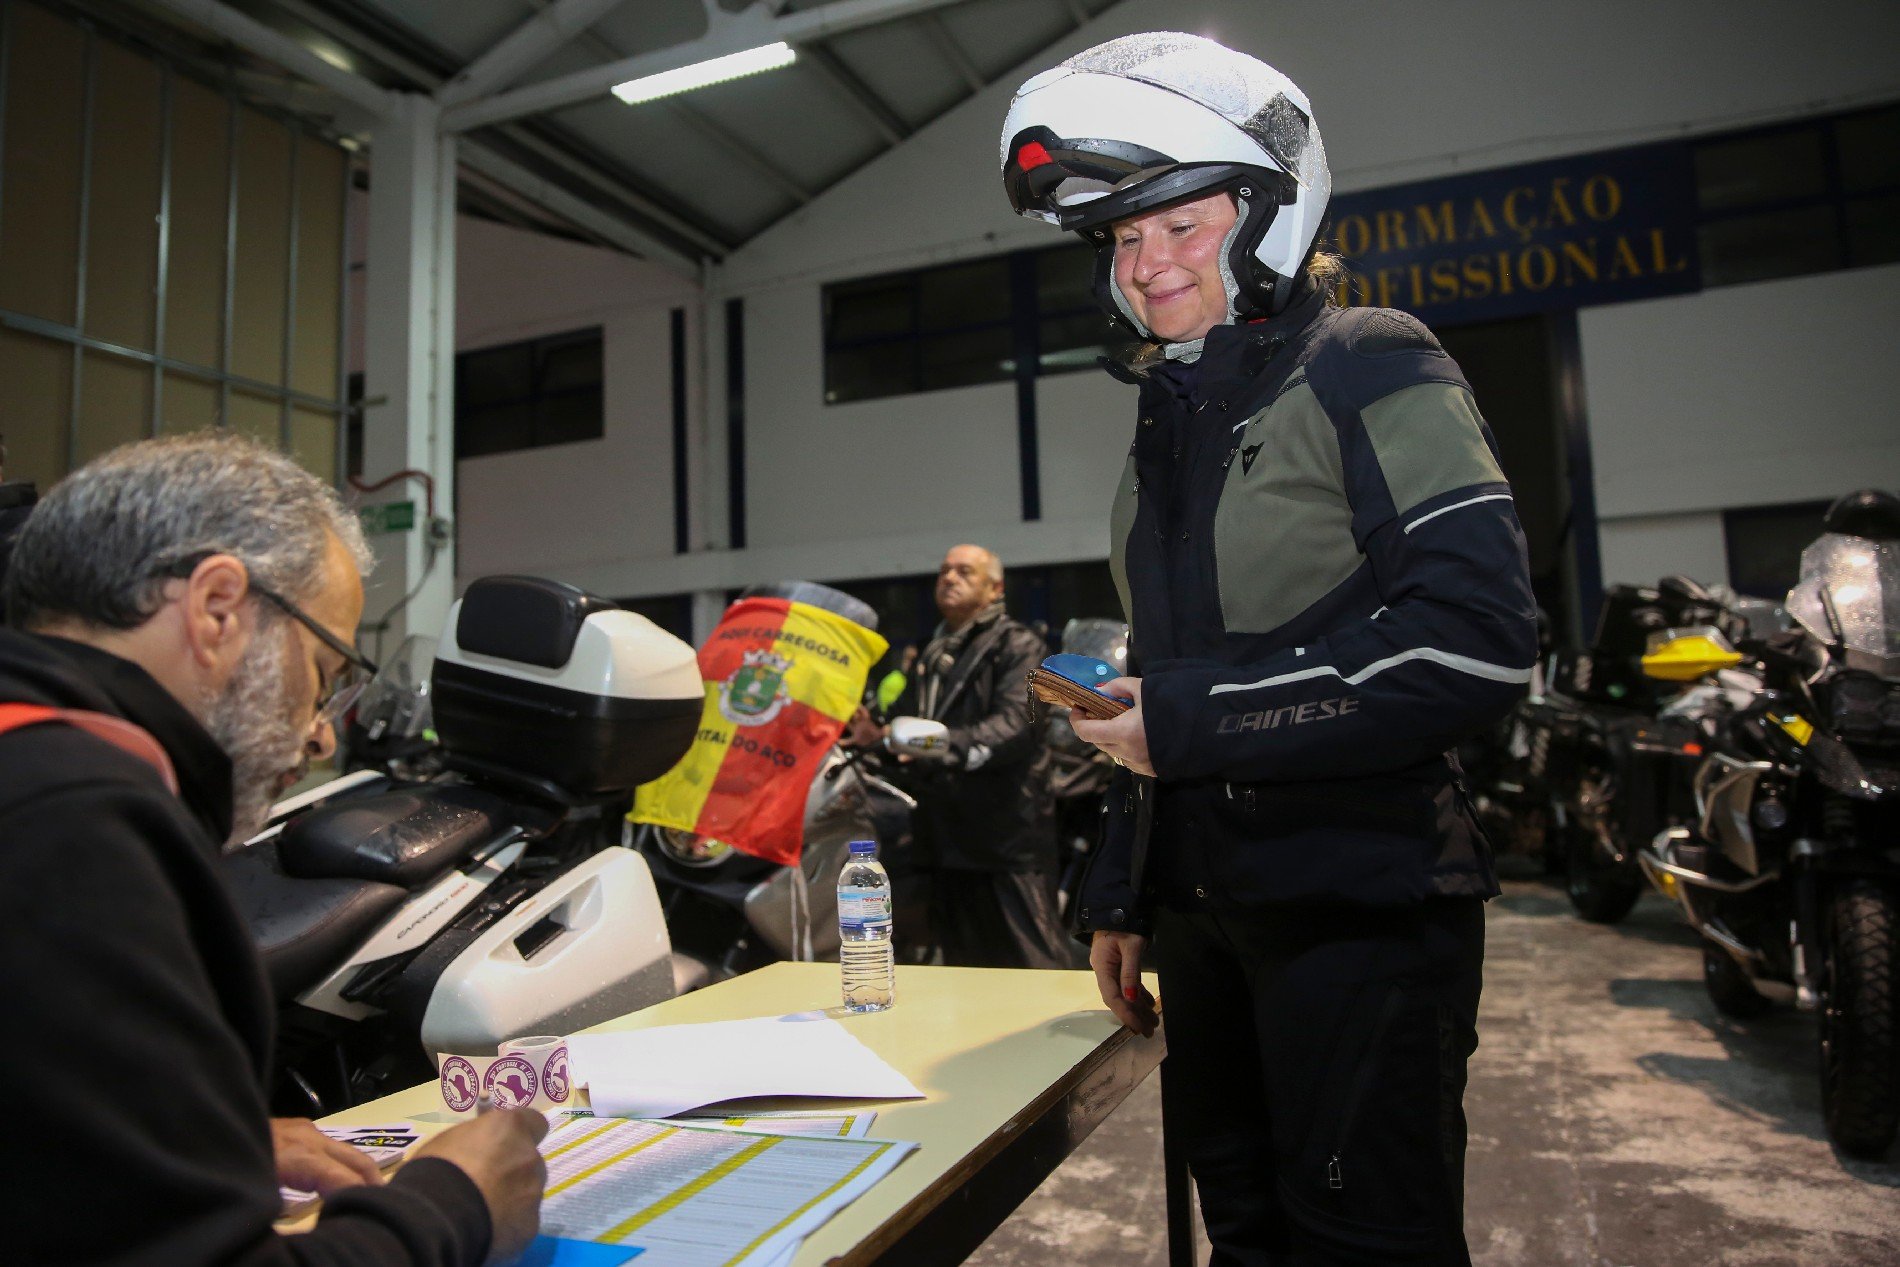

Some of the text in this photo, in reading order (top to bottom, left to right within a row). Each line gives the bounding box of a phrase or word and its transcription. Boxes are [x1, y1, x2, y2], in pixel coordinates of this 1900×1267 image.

[1335, 173, 1622, 257] ORMAÇÃO
[1335, 227, 1689, 307] OFISSIONAL
[753, 628, 850, 666] CARREGOSA
[1216, 693, 1361, 734] DAINESE
[731, 735, 758, 752] DO
[761, 744, 796, 768] AÇO
